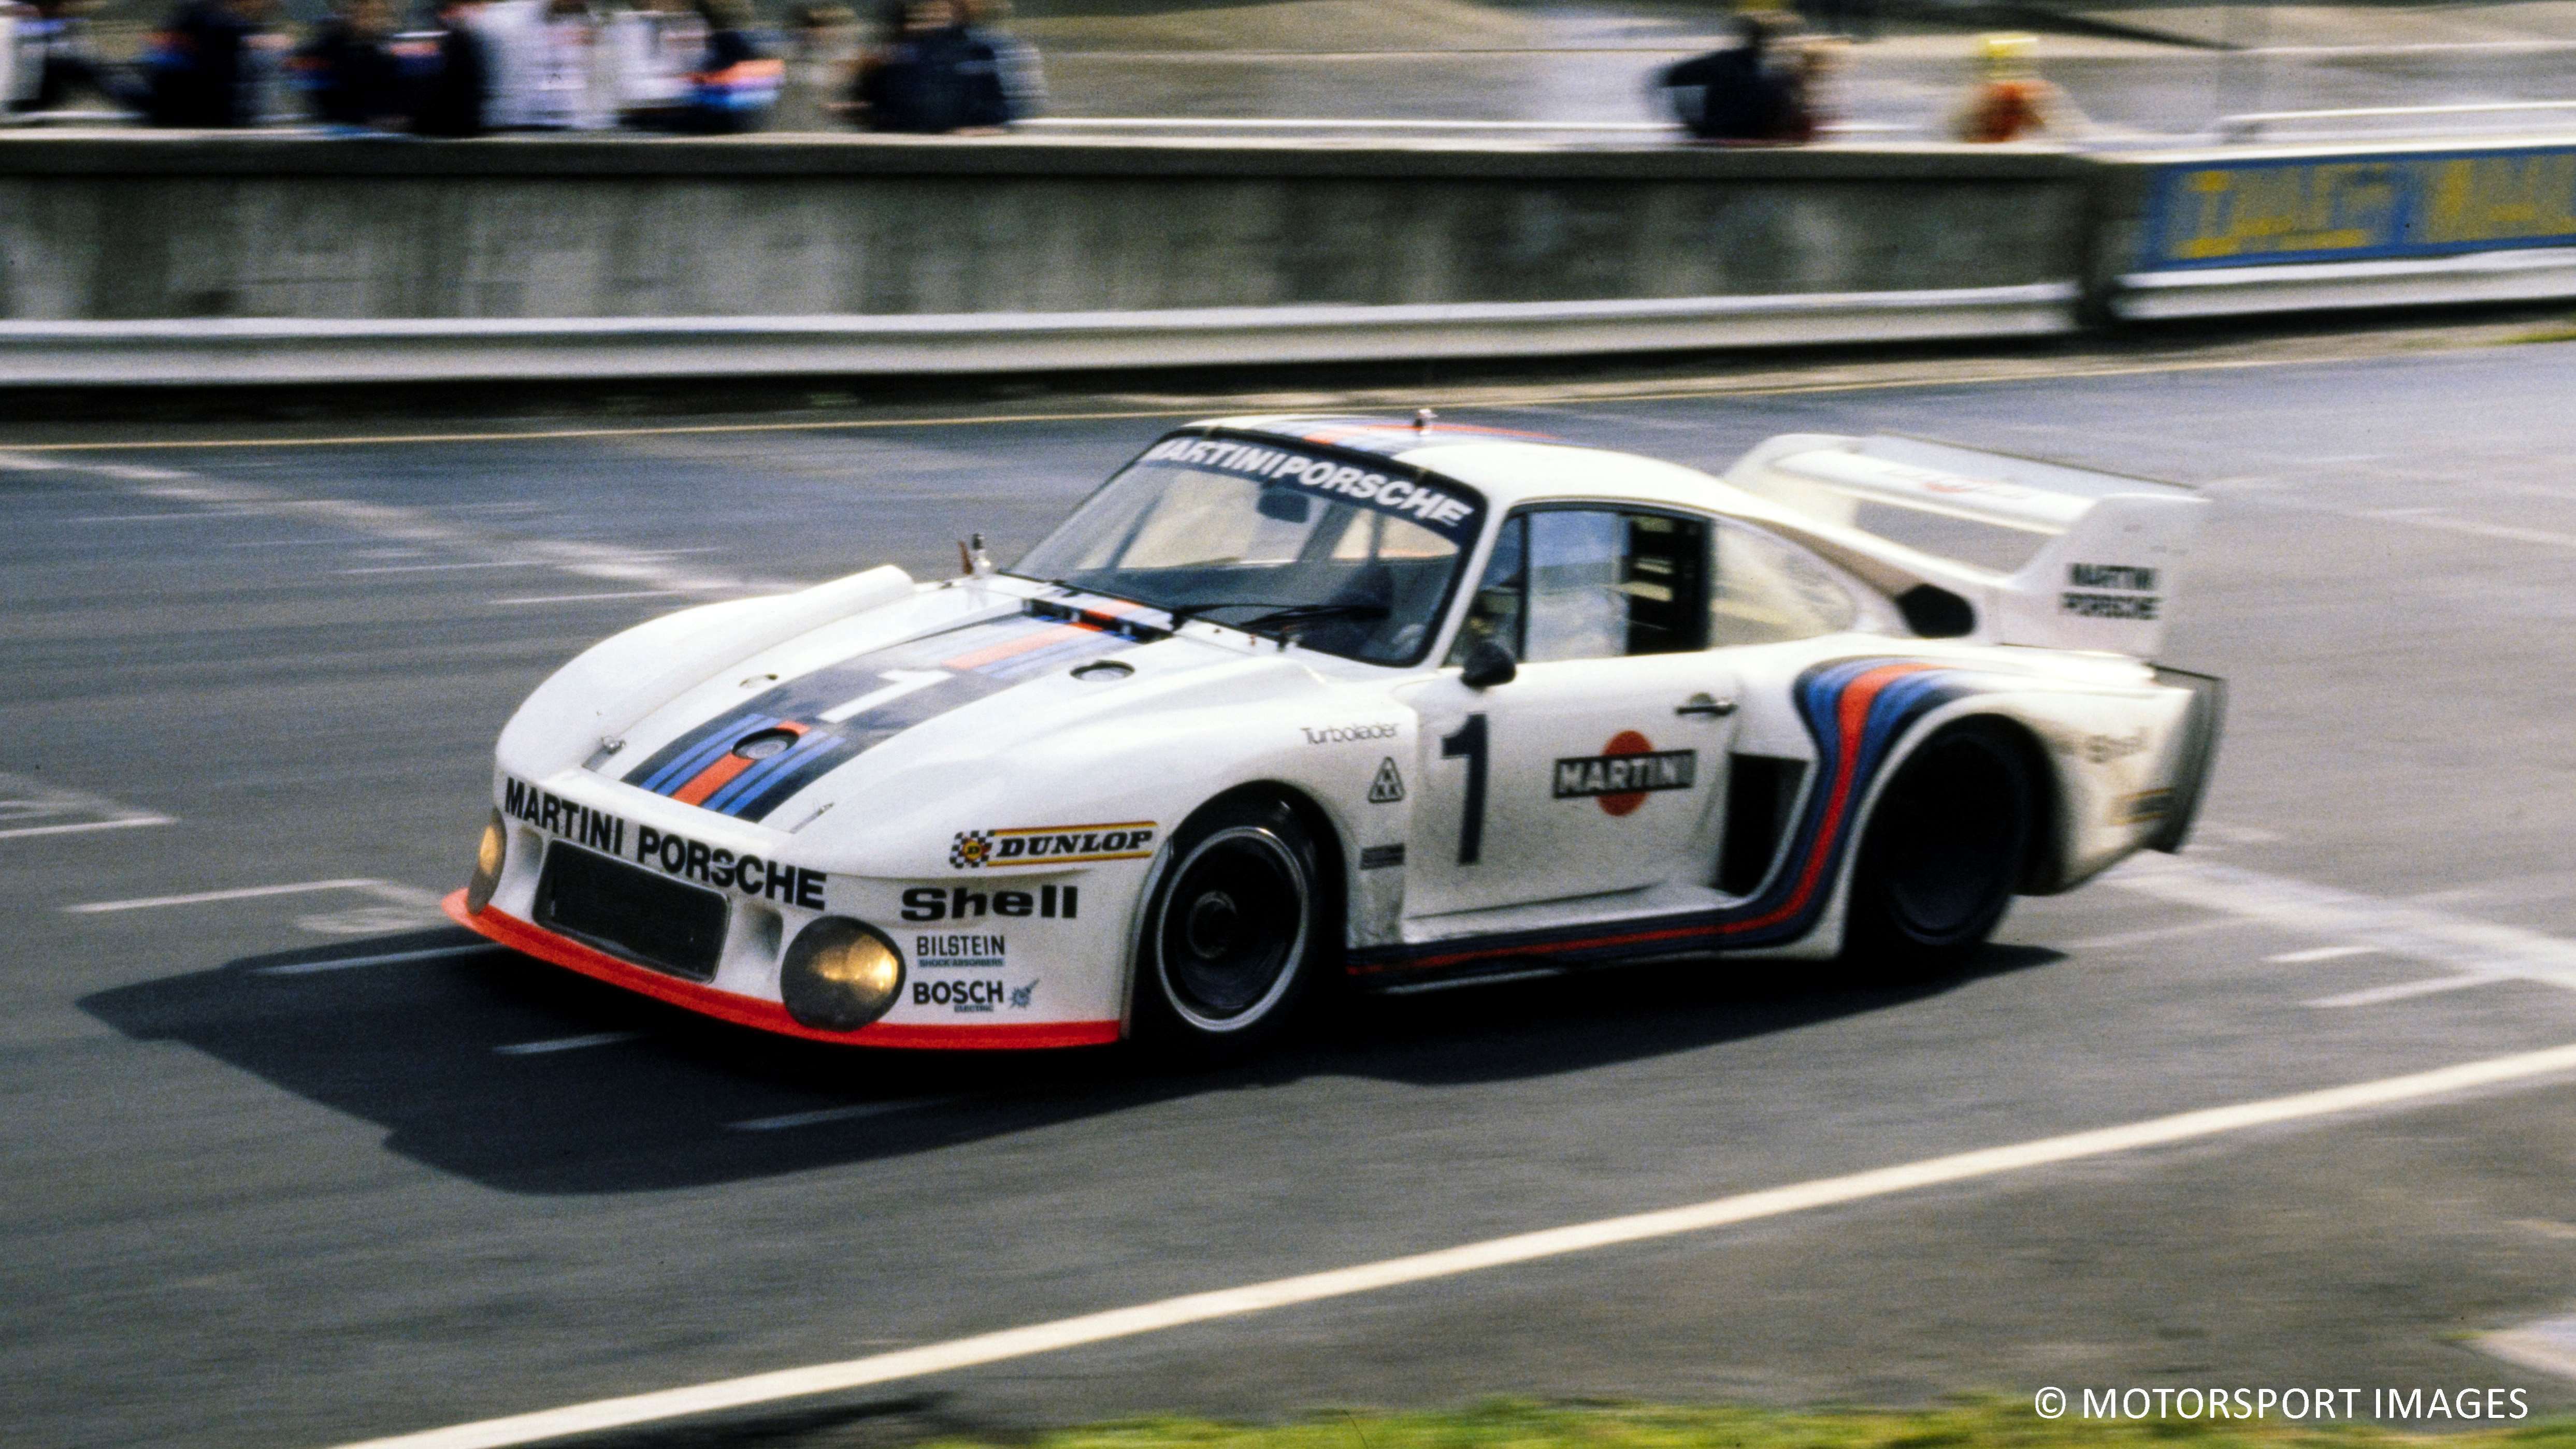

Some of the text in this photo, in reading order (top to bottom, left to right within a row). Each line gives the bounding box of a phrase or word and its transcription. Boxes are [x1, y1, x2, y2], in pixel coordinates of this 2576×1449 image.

[1141, 438, 1474, 527] MARTINI PORSCHE
[816, 667, 956, 723] 1
[1442, 713, 1488, 866] 1
[505, 777, 827, 910] MARTINI PORSCHE
[996, 830, 1153, 857] DUNLOP
[901, 885, 1077, 921] Shell
[917, 936, 1005, 955] BILSTEIN
[913, 981, 1003, 1005] BOSCH
